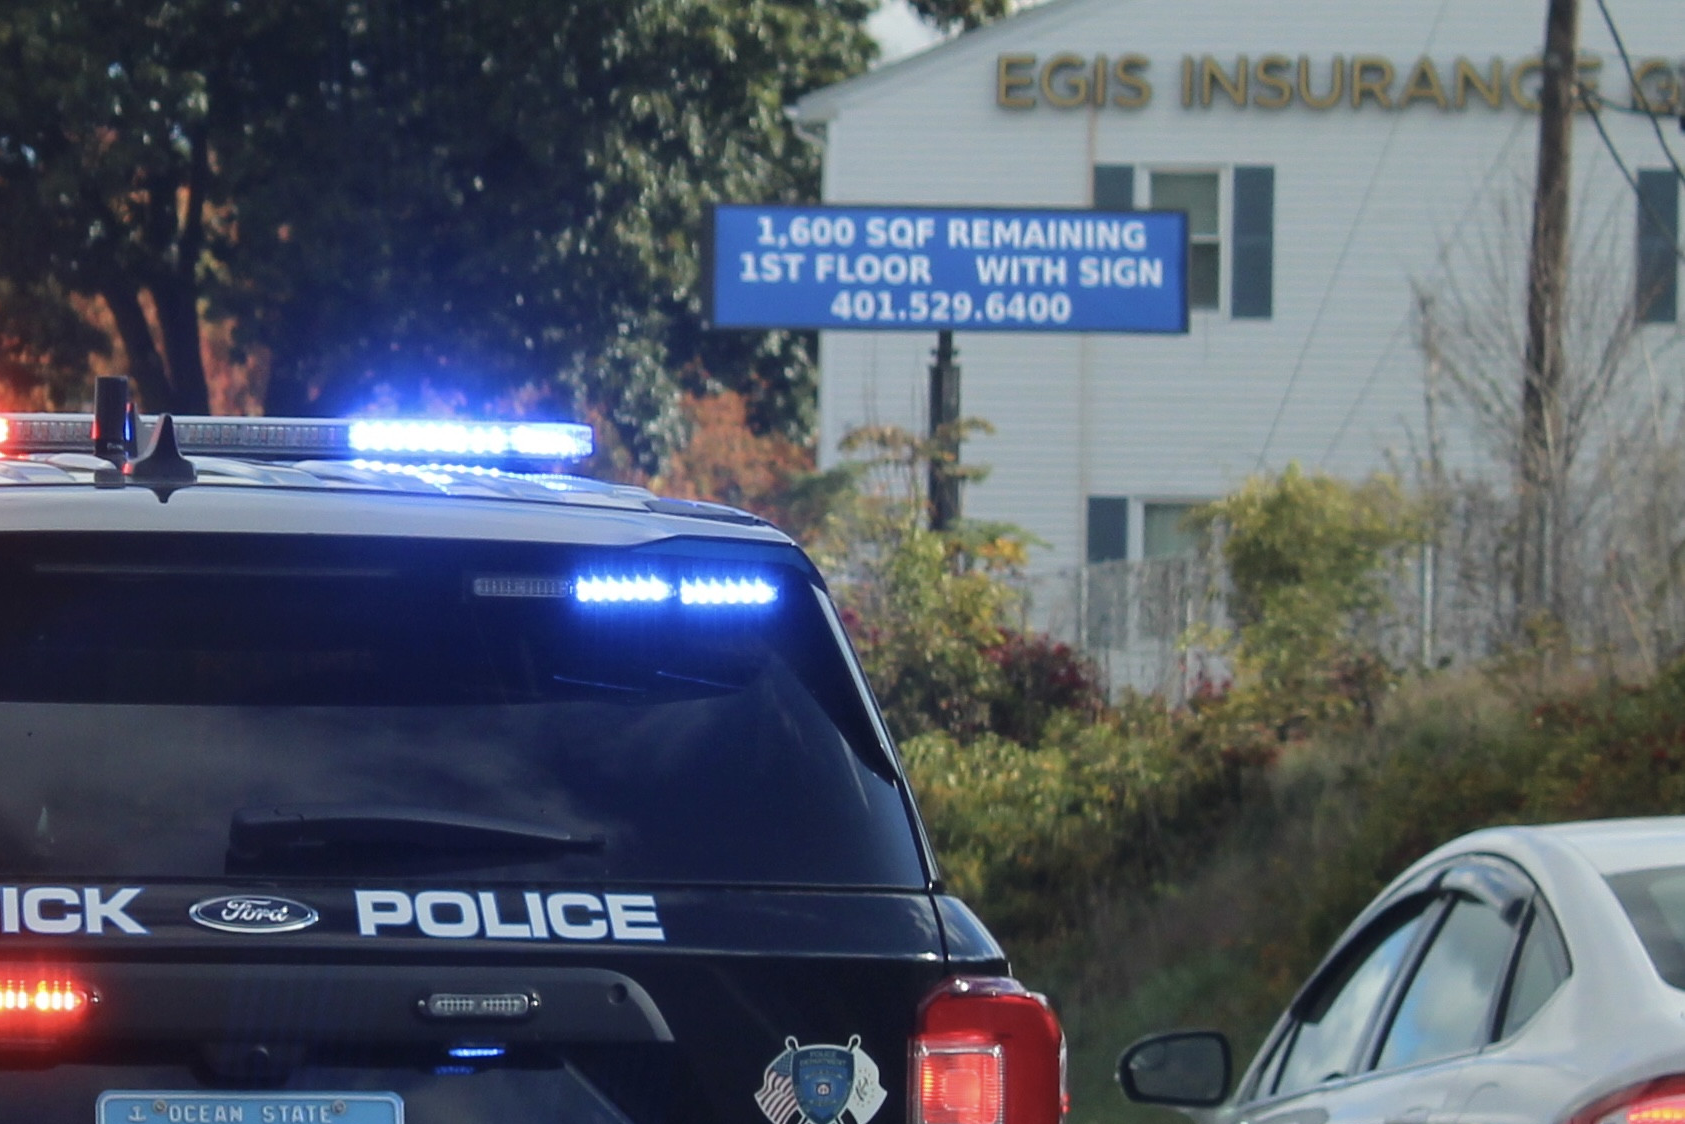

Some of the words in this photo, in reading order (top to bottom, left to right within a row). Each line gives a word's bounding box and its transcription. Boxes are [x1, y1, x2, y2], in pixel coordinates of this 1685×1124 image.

[996, 54, 1153, 107] EGIS
[757, 215, 855, 249] 1,600
[865, 218, 936, 252] SQF
[948, 219, 1147, 250] REMAINING
[739, 252, 806, 282] 1ST
[816, 254, 932, 285] FLOOR
[975, 257, 1068, 286] WITH
[1079, 258, 1163, 288] SIGN
[830, 291, 1072, 323] 401.529.6400
[220, 900, 289, 921] Ford
[354, 889, 666, 941] POLICE
[169, 1105, 243, 1124] OCEAN
[263, 1105, 332, 1124] STATE
